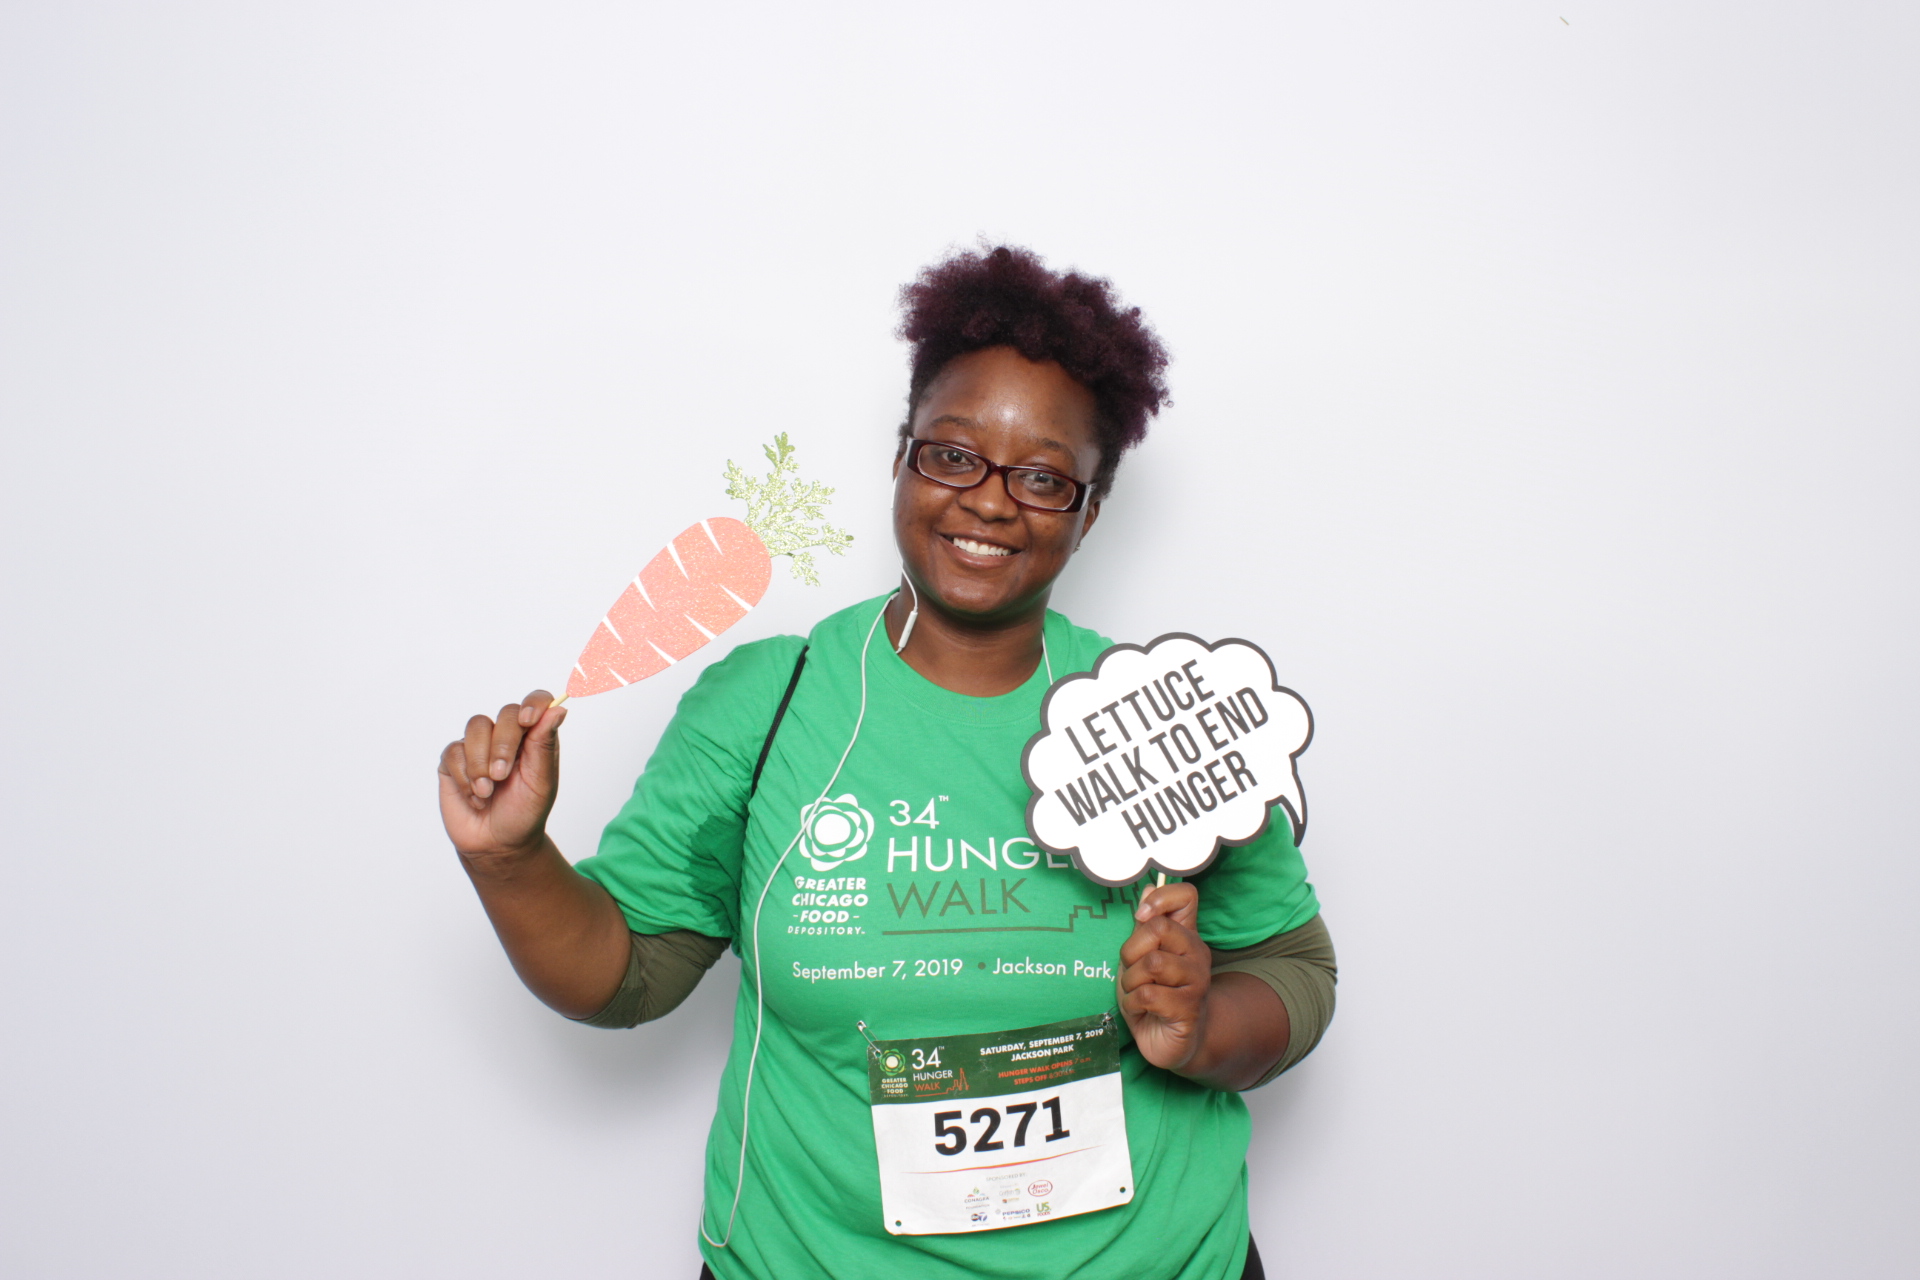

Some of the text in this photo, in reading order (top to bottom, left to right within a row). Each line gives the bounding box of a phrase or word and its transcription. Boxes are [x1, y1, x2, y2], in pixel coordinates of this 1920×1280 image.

[1064, 659, 1215, 765] LETTUCE
[1054, 686, 1269, 827] WALK TO END
[1120, 750, 1258, 850] HUNGER
[887, 836, 1078, 873] HUNG
[794, 876, 867, 891] GREATER
[792, 893, 869, 907] CHICAGO
[886, 878, 1031, 919] WALK
[787, 925, 863, 935] DEPOSITORY
[792, 957, 1116, 984] September 7, 2019 Jackson Park,
[980, 1028, 1104, 1056] SATURDAY, SEPTEMBER 7, 2019
[1011, 1044, 1075, 1062] JACKSON PARK
[912, 1069, 954, 1082] HUNGER
[998, 1068, 1029, 1078] HUNGER
[1029, 1065, 1050, 1074] WALK
[1051, 1060, 1073, 1069] OPENS
[1014, 1077, 1034, 1085] STEPS
[1034, 1074, 1048, 1082] OFF
[914, 1082, 941, 1091] WALK
[934, 1096, 1071, 1156] 5271
